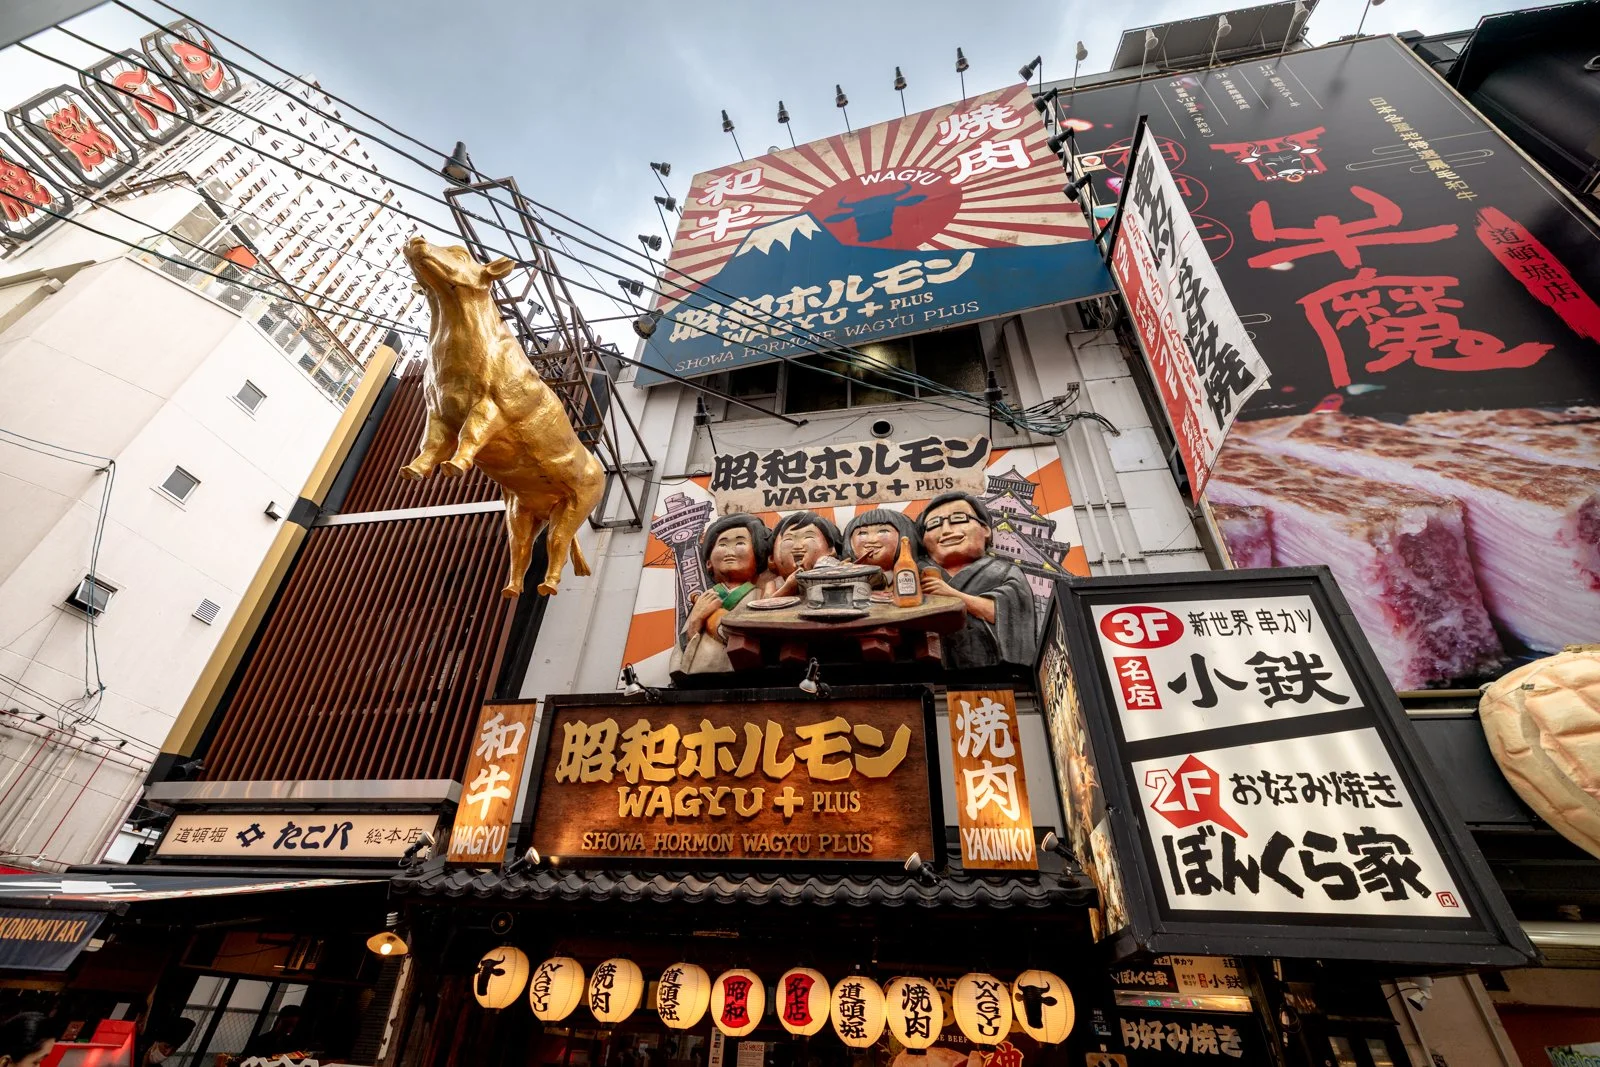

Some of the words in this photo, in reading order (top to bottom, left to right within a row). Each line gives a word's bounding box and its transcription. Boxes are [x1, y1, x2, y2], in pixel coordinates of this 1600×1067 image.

[937, 103, 1034, 184] 焼肉
[859, 167, 942, 187] WAGYU
[689, 167, 765, 244] 和牛
[1487, 226, 1580, 304] 道頓堀店
[669, 250, 975, 343] 昭和ホルモン
[721, 305, 848, 348] WAGYU
[889, 291, 934, 311] PLUS
[674, 350, 734, 373] SHOWA
[742, 328, 836, 358] HORMONE
[844, 313, 915, 336] WAGYU
[923, 300, 980, 322] PLUS
[710, 434, 989, 492] 昭和ホルモン
[762, 481, 878, 508] WAGYU
[915, 477, 954, 493] PLUS
[1110, 612, 1169, 645] 3F
[1188, 609, 1253, 637] 新世界
[1255, 608, 1313, 636] 串カツ
[1121, 659, 1156, 708] 名店
[1167, 650, 1350, 709] 小鉄
[466, 711, 526, 820] 和牛
[554, 716, 912, 785] 昭和ホルモン
[956, 697, 1020, 822] 焼肉
[617, 785, 765, 819] WAGYU
[812, 790, 861, 814] PLUS
[1144, 768, 1212, 813] 2F
[1228, 770, 1403, 809] お好み焼き
[172, 826, 229, 844] 道頓堀
[272, 821, 353, 850] たこ八
[363, 827, 424, 845] 総本店
[451, 825, 506, 856] WAGYU
[581, 831, 646, 852] SHOWA
[653, 832, 734, 853] HORMON
[741, 833, 812, 853] WAGYU
[818, 833, 873, 854] PLUS
[962, 827, 1032, 863] YAKINIKU
[1161, 825, 1432, 902] ぼんくら家
[533, 962, 564, 1013] WAGYU
[590, 963, 618, 1014] 焼肉
[658, 967, 684, 1022] 道頓堀
[724, 981, 747, 1021] 昭和
[786, 977, 809, 1021] 名店
[1208, 974, 1245, 990] 小鉄
[839, 982, 868, 1039] 道頓堀
[901, 983, 932, 1039] 焼肉
[971, 980, 1003, 1037] WAGYU
[1119, 1017, 1244, 1058] お好み焼き
